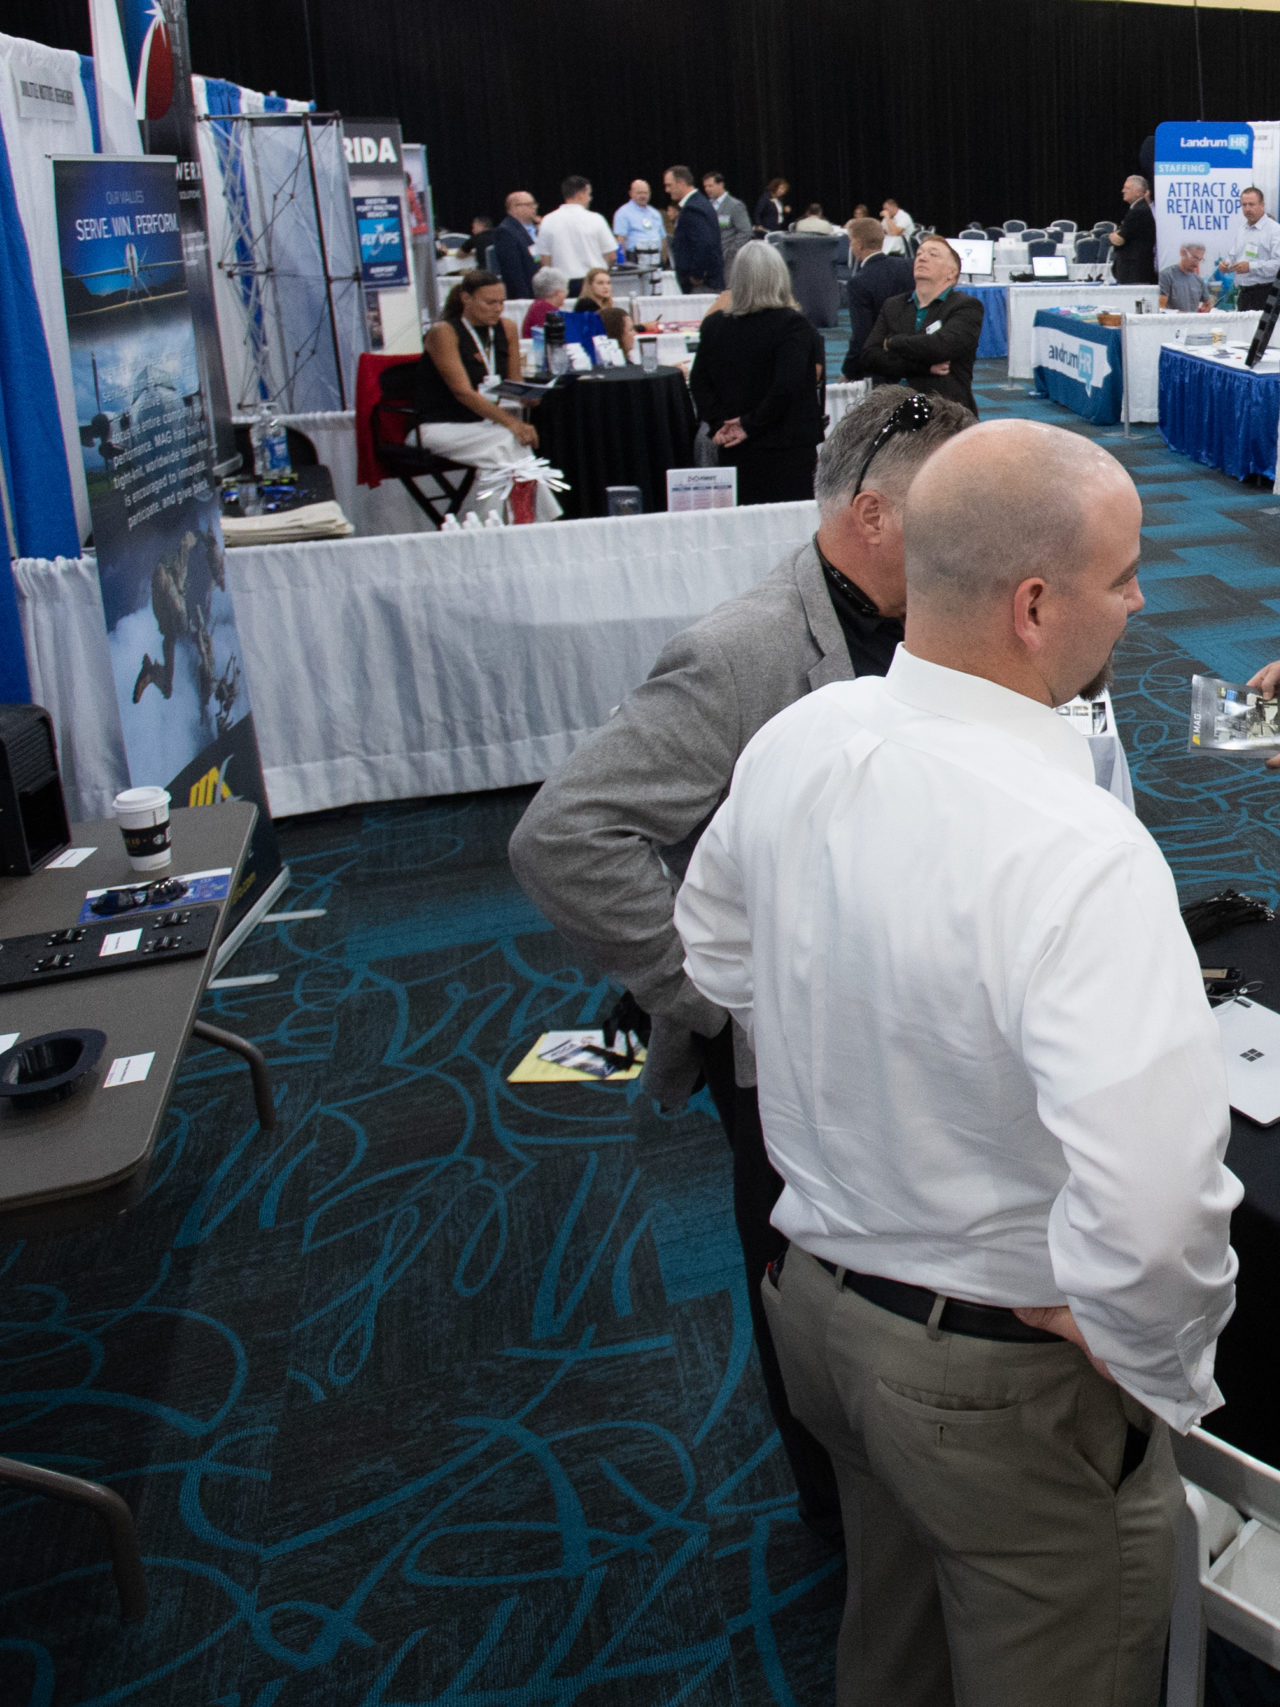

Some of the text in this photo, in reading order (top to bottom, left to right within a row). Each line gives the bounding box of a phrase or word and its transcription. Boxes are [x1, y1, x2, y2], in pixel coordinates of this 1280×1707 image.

[1158, 164, 1206, 173] STAFFING
[1168, 182, 1240, 197] ATTRACT &
[1167, 199, 1242, 214] RETAIN TOP
[75, 213, 180, 241] SERVE. WIN. PERFORM.
[1182, 215, 1230, 230] TALENT
[361, 232, 400, 245] FLY VPS
[154, 430, 173, 447] MAG
[132, 476, 168, 505] encouraged
[168, 471, 177, 483] to
[162, 493, 176, 509] and
[177, 487, 193, 505] give
